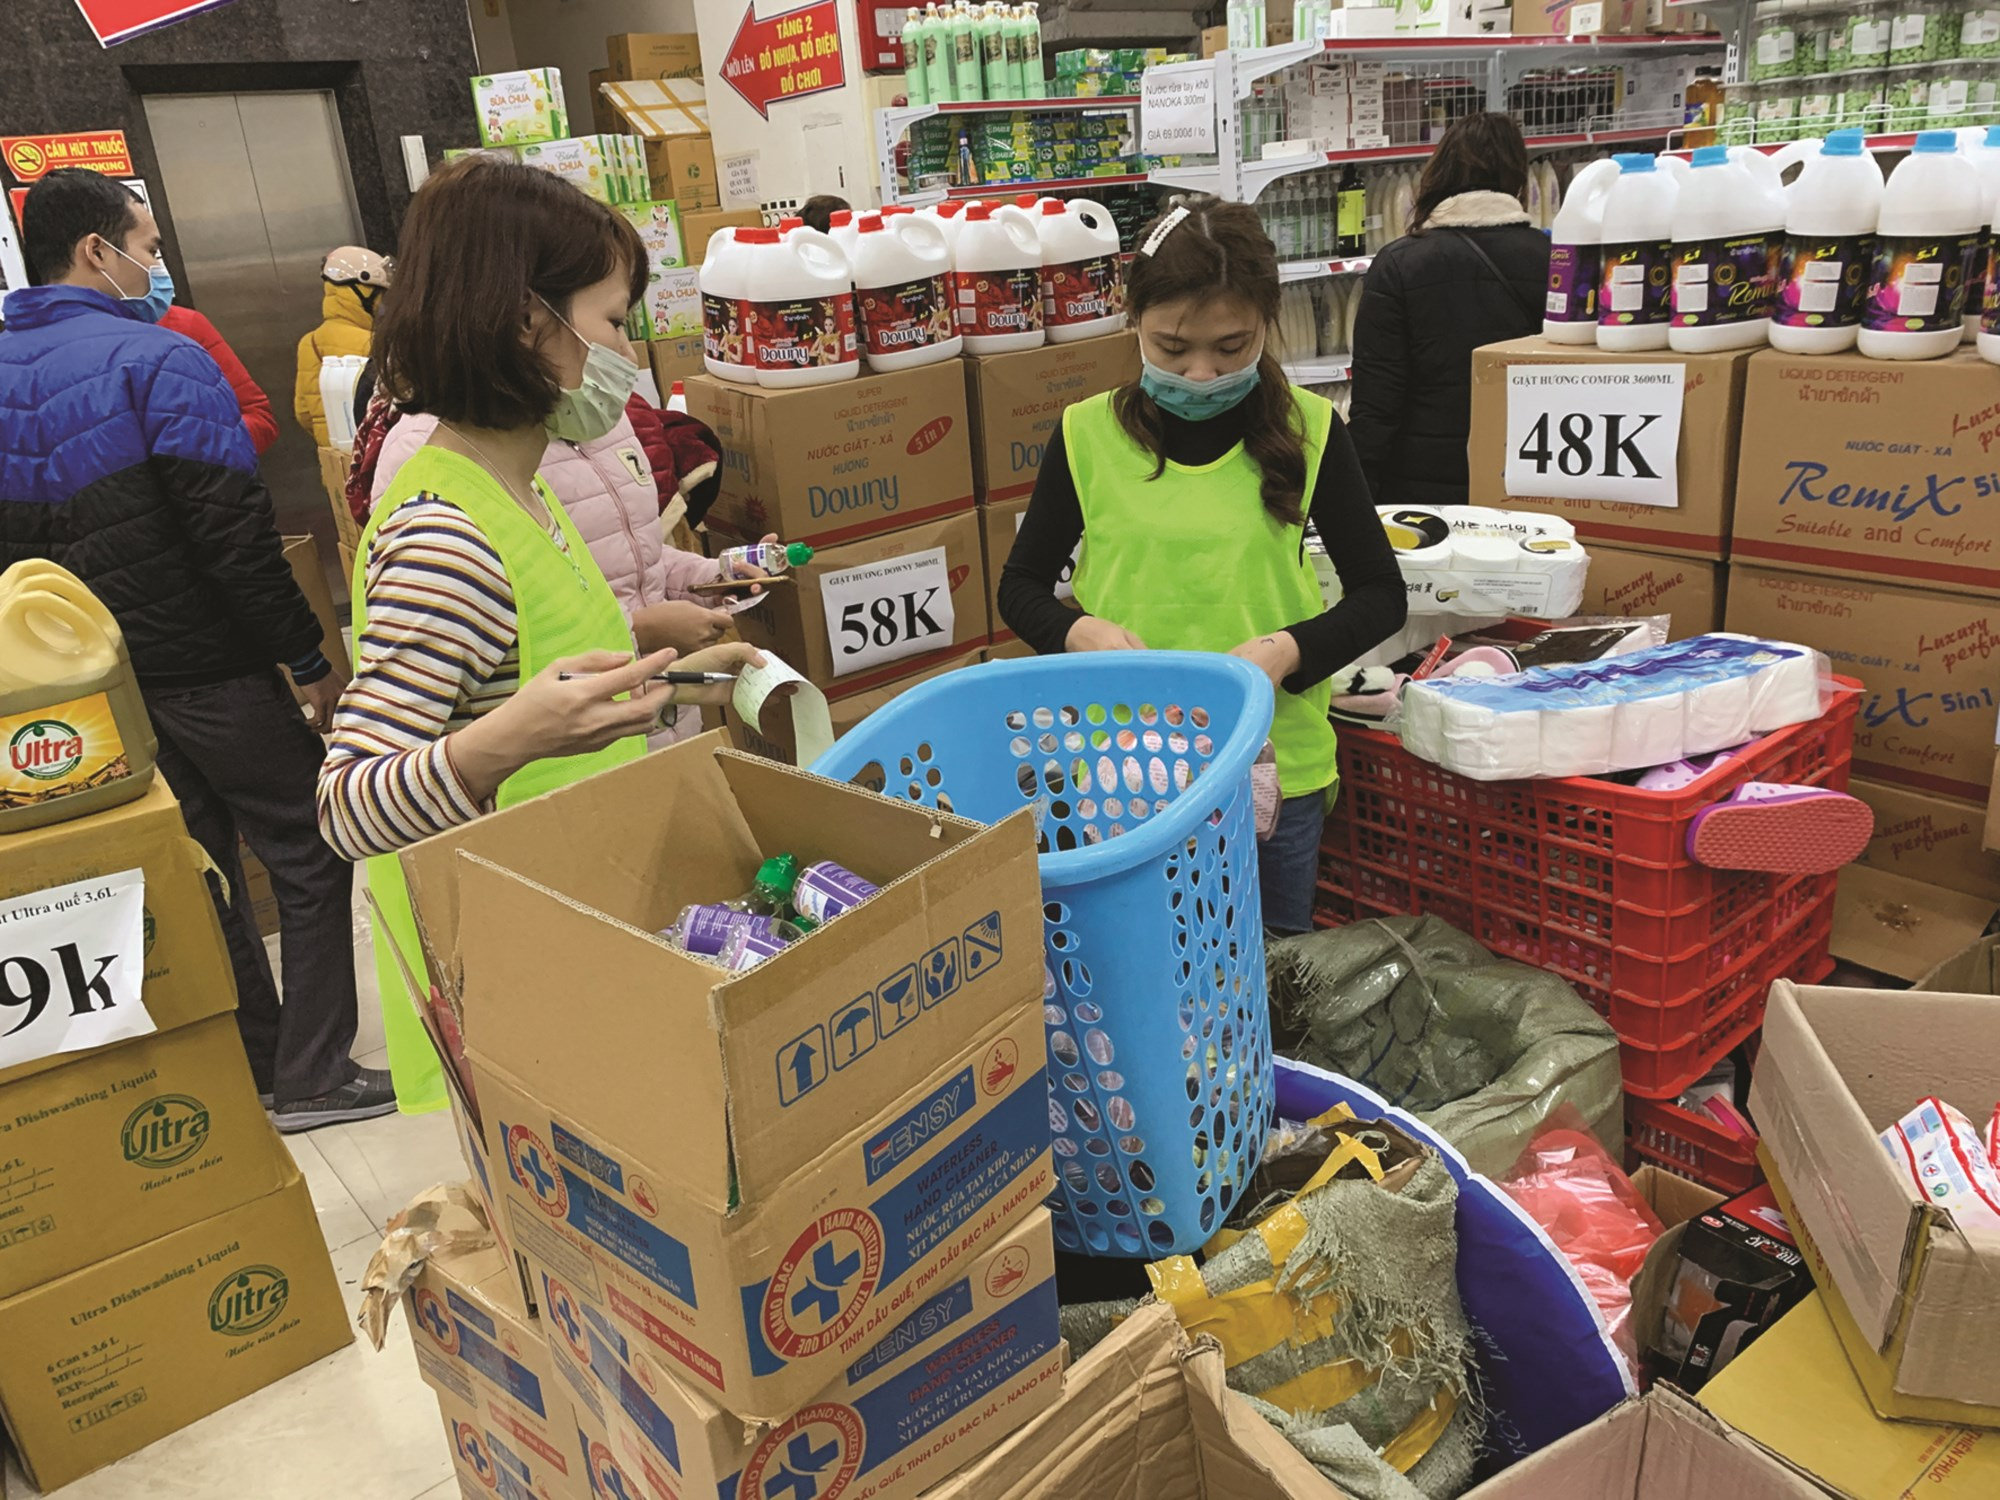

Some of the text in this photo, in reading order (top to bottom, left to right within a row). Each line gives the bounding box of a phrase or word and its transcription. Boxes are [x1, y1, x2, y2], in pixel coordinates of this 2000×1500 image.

[805, 15, 813, 32] 2
[815, 31, 838, 58] ĐIỆN
[741, 54, 755, 74] LÊN
[796, 67, 821, 90] CHƠI
[509, 93, 531, 104] CHUA
[1148, 92, 1206, 108] NANOKA 300ml
[1184, 81, 1194, 93] tay
[45, 136, 124, 158] CẤM HÚT THUỐC
[1148, 128, 1161, 140] GIÁ
[559, 159, 584, 172] CHUA
[676, 287, 698, 298] CHUA
[1066, 297, 1107, 316] Downy
[879, 325, 927, 347] Downy
[988, 310, 1029, 329] Downy
[759, 345, 809, 365] Downy
[857, 386, 882, 399] SUPER
[1512, 375, 1538, 388] GIẶT
[1540, 375, 1579, 386] HƯƠNG
[1581, 375, 1630, 386] COMFOR
[1632, 375, 1675, 386] 3600ML
[1779, 368, 1904, 384] LIQUID DETERGENT
[834, 397, 908, 420] LIQUID DETERGENT
[914, 437, 924, 451] 5
[924, 428, 938, 444] in
[1519, 412, 1663, 479] 48K
[808, 474, 899, 519] Downy
[1564, 496, 1592, 509] and
[1776, 514, 1992, 556] Suitable and Comfort
[884, 563, 913, 576] DOWNY
[914, 557, 940, 571] 3600ML
[1603, 571, 1656, 606] Luxury
[1622, 573, 1684, 617] perfume
[1759, 578, 1874, 602] LIQUID DETERGENT
[840, 586, 946, 655] 58K
[1918, 618, 1990, 657] Luxury
[1940, 688, 1993, 713] 5in1
[11, 735, 83, 770] Ultra
[1884, 736, 1954, 765] Comfort
[1873, 815, 1933, 838] uxury
[1891, 823, 1970, 861] perfume
[12, 887, 117, 921] Ultra quế 3,6L
[0, 942, 119, 1037] 9k
[15, 1068, 158, 1128] Dishwashing Liquid
[123, 1109, 210, 1161] Ultra
[871, 1084, 960, 1176] FENSY
[916, 1133, 983, 1195] WATERLESS
[903, 1140, 998, 1226] HAND CLEANER
[906, 1153, 1011, 1245] NƯỚC RỬA TAY KHÔ
[929, 1217, 955, 1245] KHỬ
[994, 1170, 1010, 1189] CÁ
[1009, 1144, 1038, 1174] NHÂN
[823, 1211, 879, 1279] HAND SANITIZER
[839, 1326, 865, 1355] TINH
[915, 1267, 939, 1290] TINH
[940, 1246, 960, 1270] DẦU
[961, 1227, 982, 1252] BẠC
[982, 1213, 997, 1233] HÀ
[1002, 1189, 1028, 1215] NANO
[1029, 1169, 1047, 1192] BẠC
[70, 1241, 240, 1326] Ultra Dishwashing Liquid
[210, 1277, 289, 1332] Ultra
[769, 1297, 787, 1340] NANO
[845, 1289, 870, 1325] TINH
[853, 1297, 953, 1377] FENSY
[924, 1319, 1000, 1374] WATERLESS
[1013, 1341, 1047, 1365] NHÂN
[47, 1364, 54, 1373] 6
[57, 1355, 80, 1368] Can
[109, 1337, 120, 1345] L
[908, 1324, 1017, 1405] HAND CLEANER
[964, 1369, 984, 1385] TAY
[987, 1348, 1014, 1372] KHÔ
[907, 1450, 932, 1470] TINH
[933, 1433, 956, 1453] DẦU
[958, 1416, 981, 1436] BẠC
[983, 1403, 998, 1419] HÀ
[1007, 1378, 1038, 1405] NANO
[1039, 1361, 1061, 1382] BẠC
[800, 1408, 859, 1461] HAND SANITIZER
[1928, 1455, 1959, 1483] PHÚC
